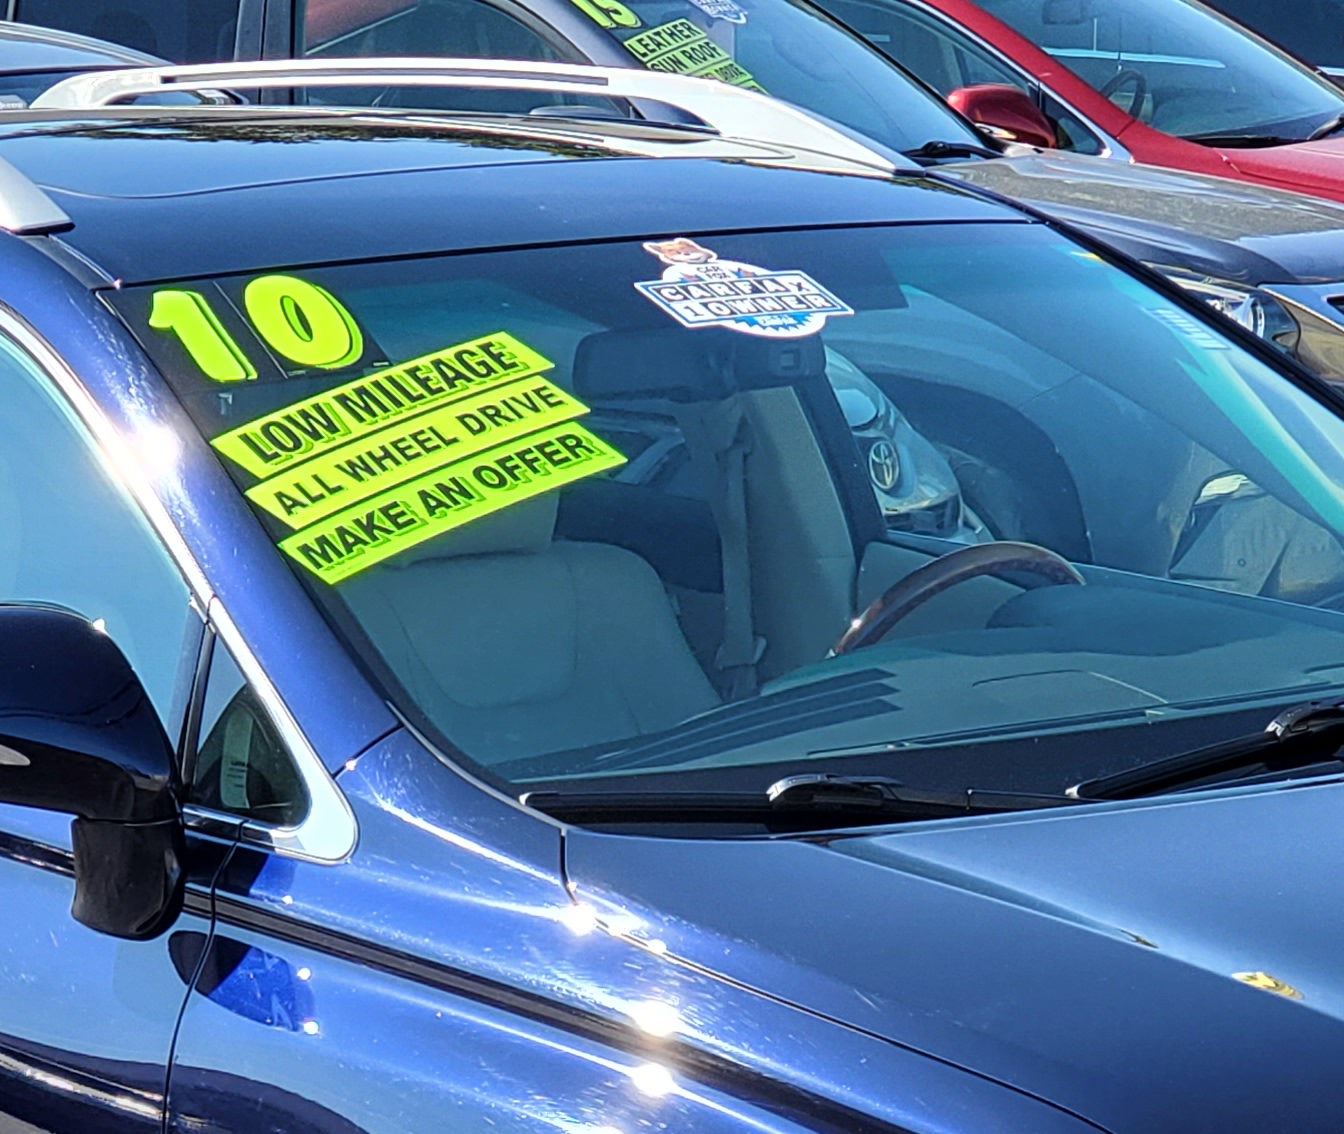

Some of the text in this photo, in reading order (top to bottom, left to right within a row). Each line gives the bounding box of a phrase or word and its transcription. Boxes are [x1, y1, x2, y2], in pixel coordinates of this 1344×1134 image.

[627, 21, 702, 58] LEATHER
[683, 41, 723, 66] ROOF
[654, 277, 813, 302] CARFAX
[683, 293, 835, 318] 1 OWNER
[148, 274, 364, 383] 10
[237, 341, 525, 464] LOW MILEAGE
[273, 384, 568, 517] ALL WHEEL DRIVE
[297, 433, 600, 570] MAKE AN OFFER
